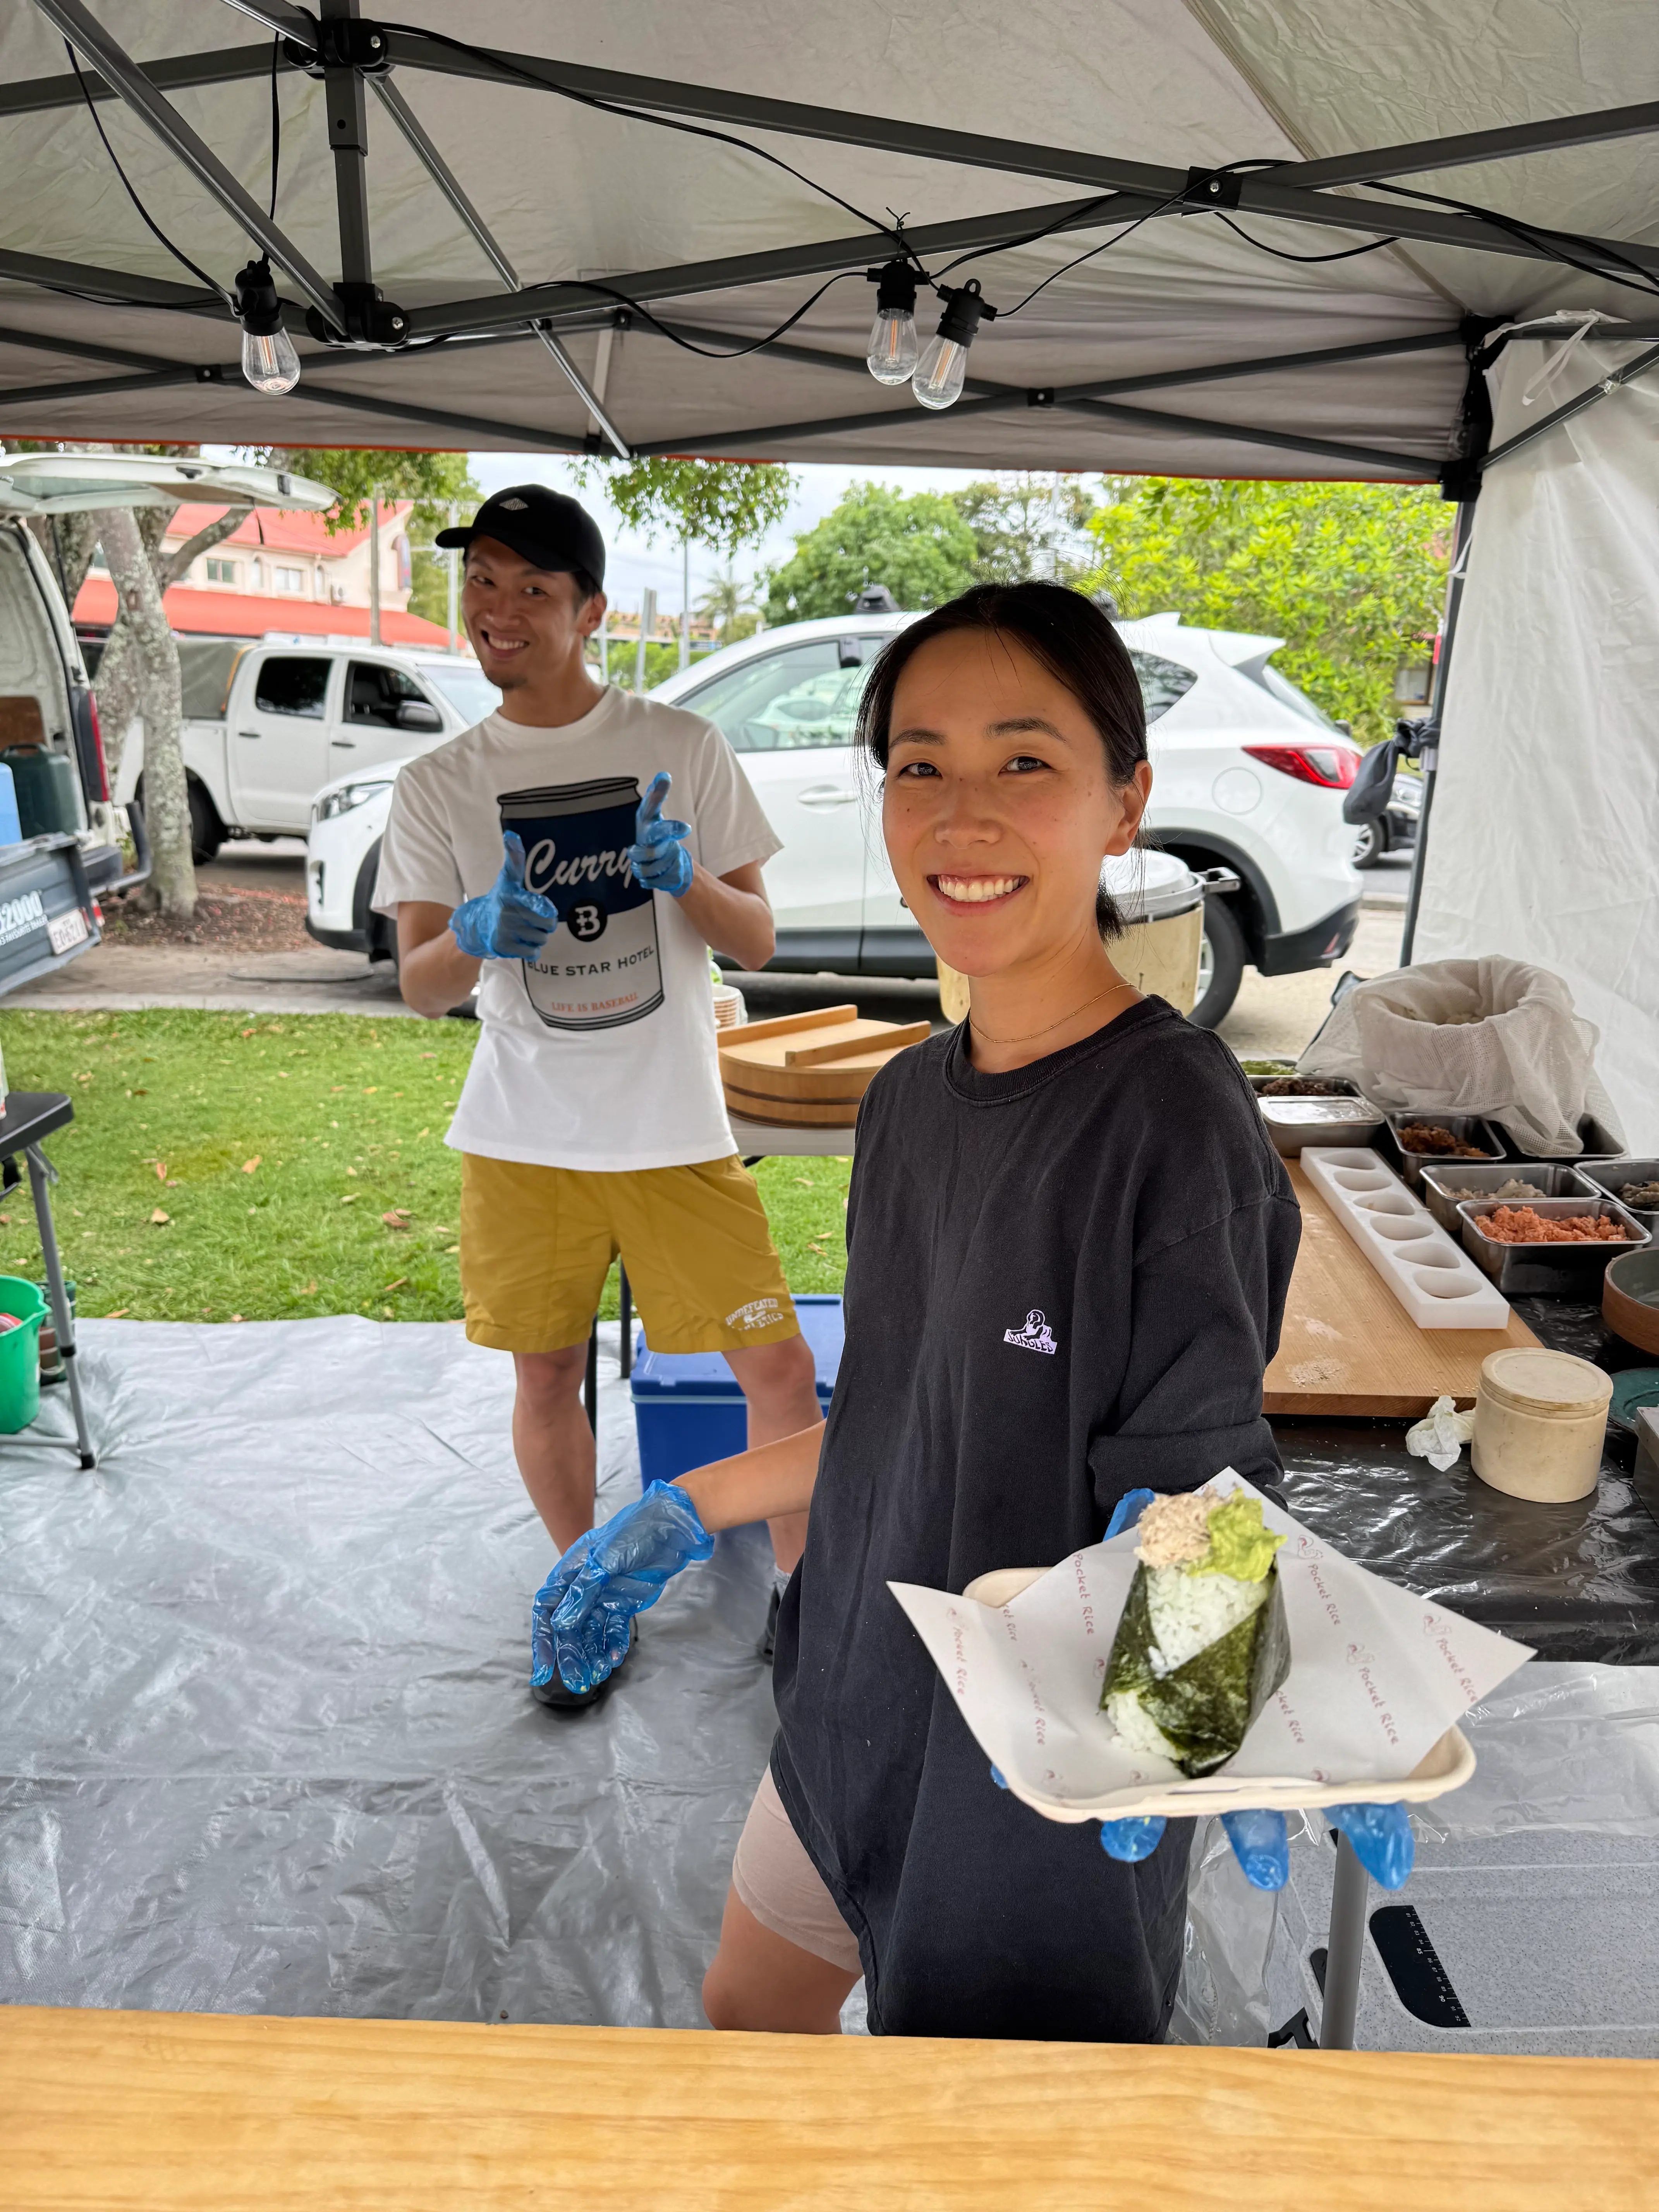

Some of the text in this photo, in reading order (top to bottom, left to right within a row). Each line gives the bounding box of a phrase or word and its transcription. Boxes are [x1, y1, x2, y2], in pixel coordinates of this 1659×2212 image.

[525, 838, 633, 893] Curry
[527, 946, 654, 976] BLUE STAR HOTEL
[551, 992, 639, 1012] LIFE IS BASEBALL
[725, 1298, 778, 1326] UNDEFEATED
[1008, 1331, 1053, 1352] JUNGLES
[1073, 1553, 1094, 1635] Pocket Rice
[1308, 1563, 1341, 1625] Pocket Rice
[1436, 1638, 1478, 1703] Pocket Rice
[1275, 1690, 1305, 1743] cket Rice
[1358, 1667, 1399, 1746] Pocket Rice
